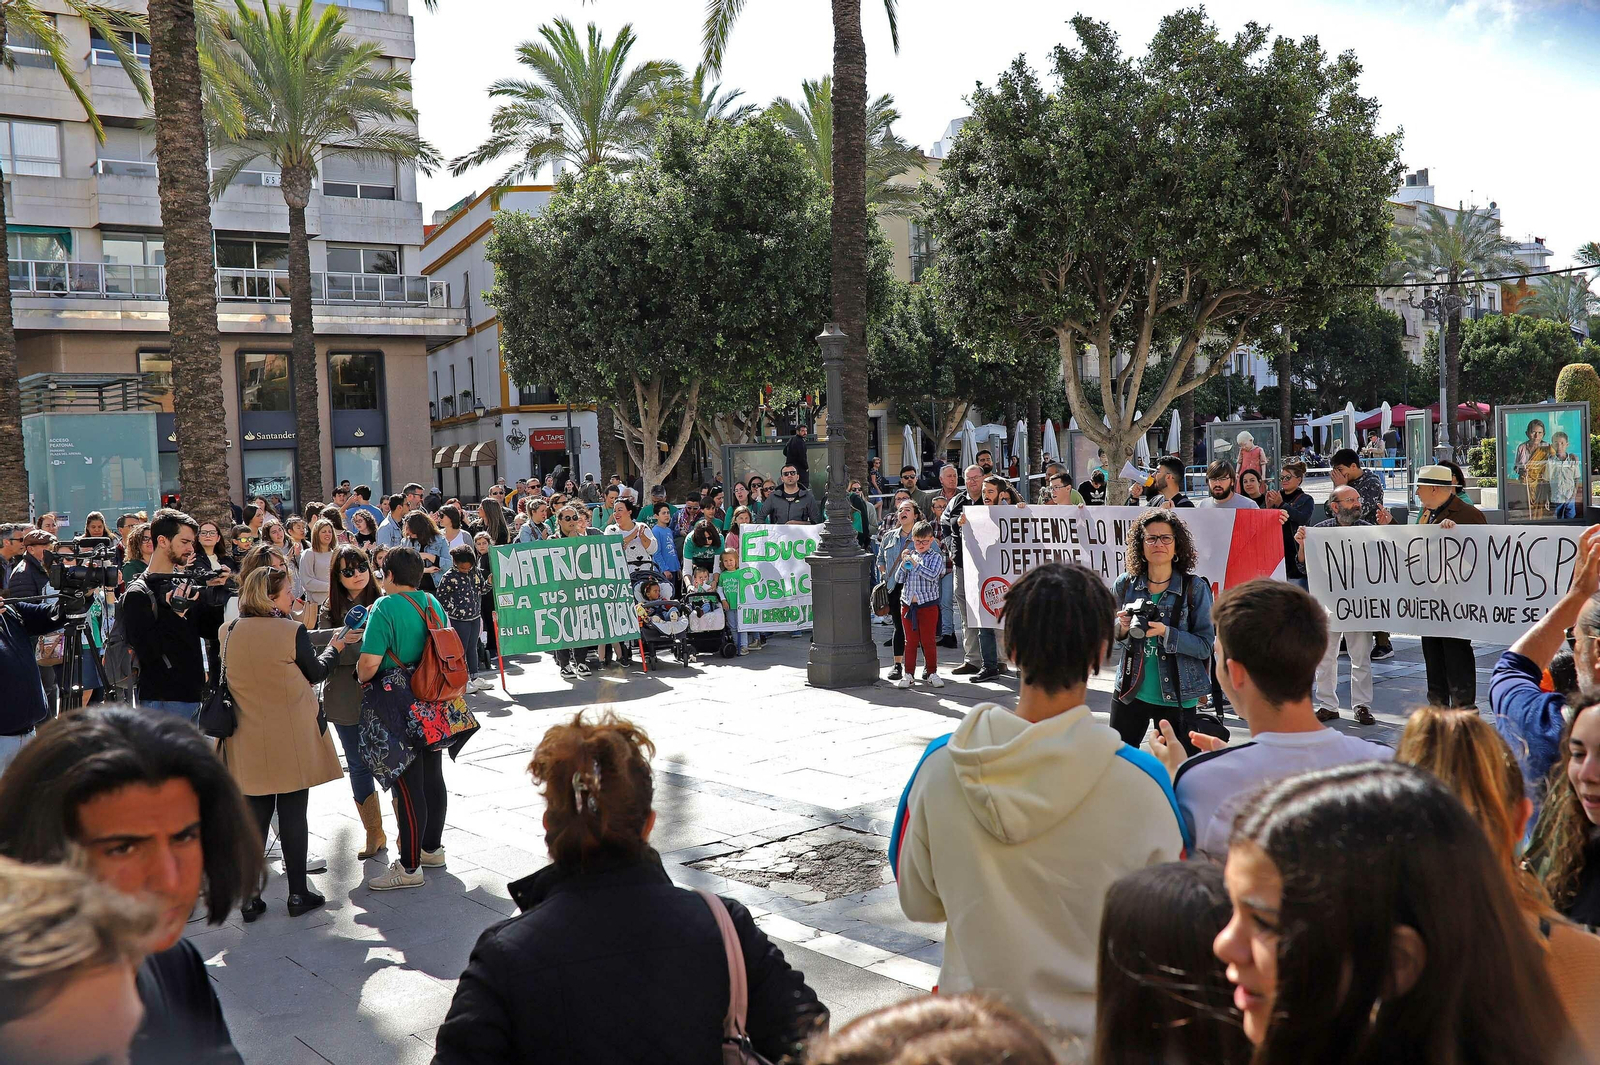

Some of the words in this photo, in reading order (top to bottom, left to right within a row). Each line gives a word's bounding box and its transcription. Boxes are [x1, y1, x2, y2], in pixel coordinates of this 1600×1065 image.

[256, 431, 295, 440] Santander
[999, 517, 1080, 544] DEFIENDE
[1085, 519, 1107, 545] LO
[1113, 519, 1132, 546] NU
[497, 542, 631, 588] MATRICULA
[1090, 550, 1110, 578] LA
[1362, 540, 1399, 585] UN
[1487, 531, 1548, 601] MÁS
[516, 595, 532, 609] A
[539, 589, 568, 606] TUS
[1336, 596, 1391, 621] QUIEN
[1396, 596, 1452, 622] QUIERA
[1453, 602, 1488, 623] CURA
[1492, 606, 1517, 624] QUE
[1521, 607, 1540, 623] SE
[500, 627, 513, 637] EN
[516, 625, 530, 636] LA
[534, 604, 605, 645] ESCUELA
[797, 605, 807, 626] Y
